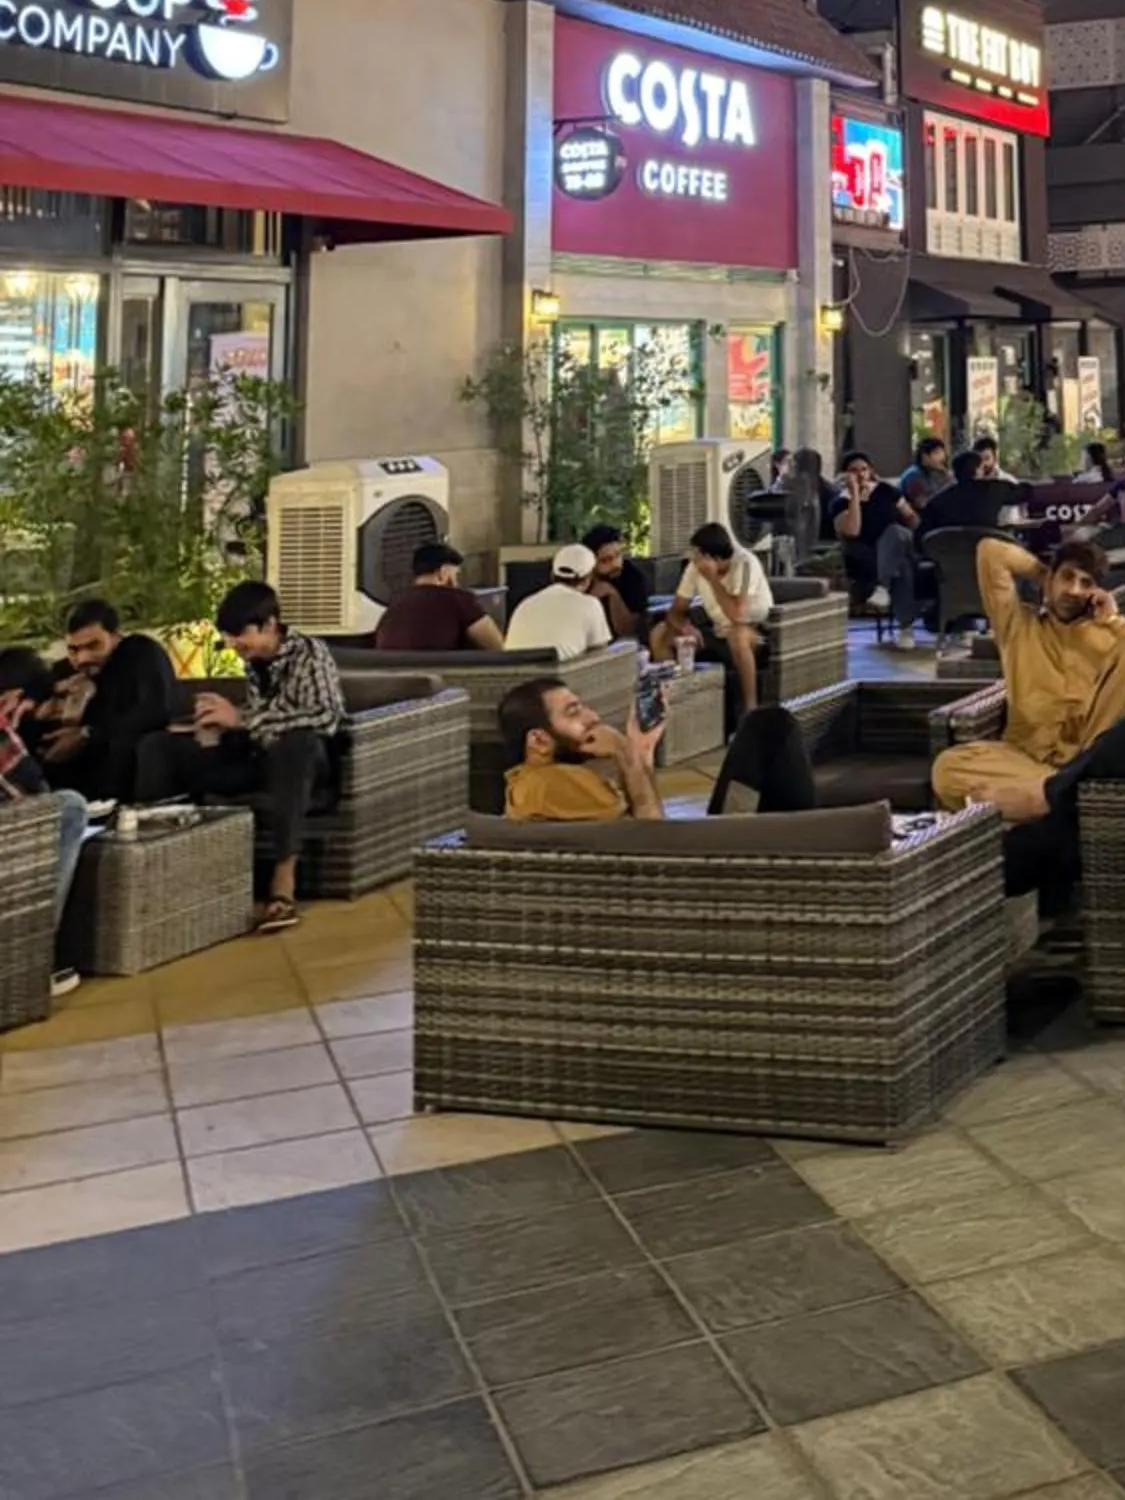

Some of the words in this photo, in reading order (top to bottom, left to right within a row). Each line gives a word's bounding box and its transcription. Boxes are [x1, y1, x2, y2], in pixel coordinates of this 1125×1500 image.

[607, 52, 756, 147] COSTA
[642, 159, 728, 201] COFFEE
[1045, 503, 1093, 522] COST
